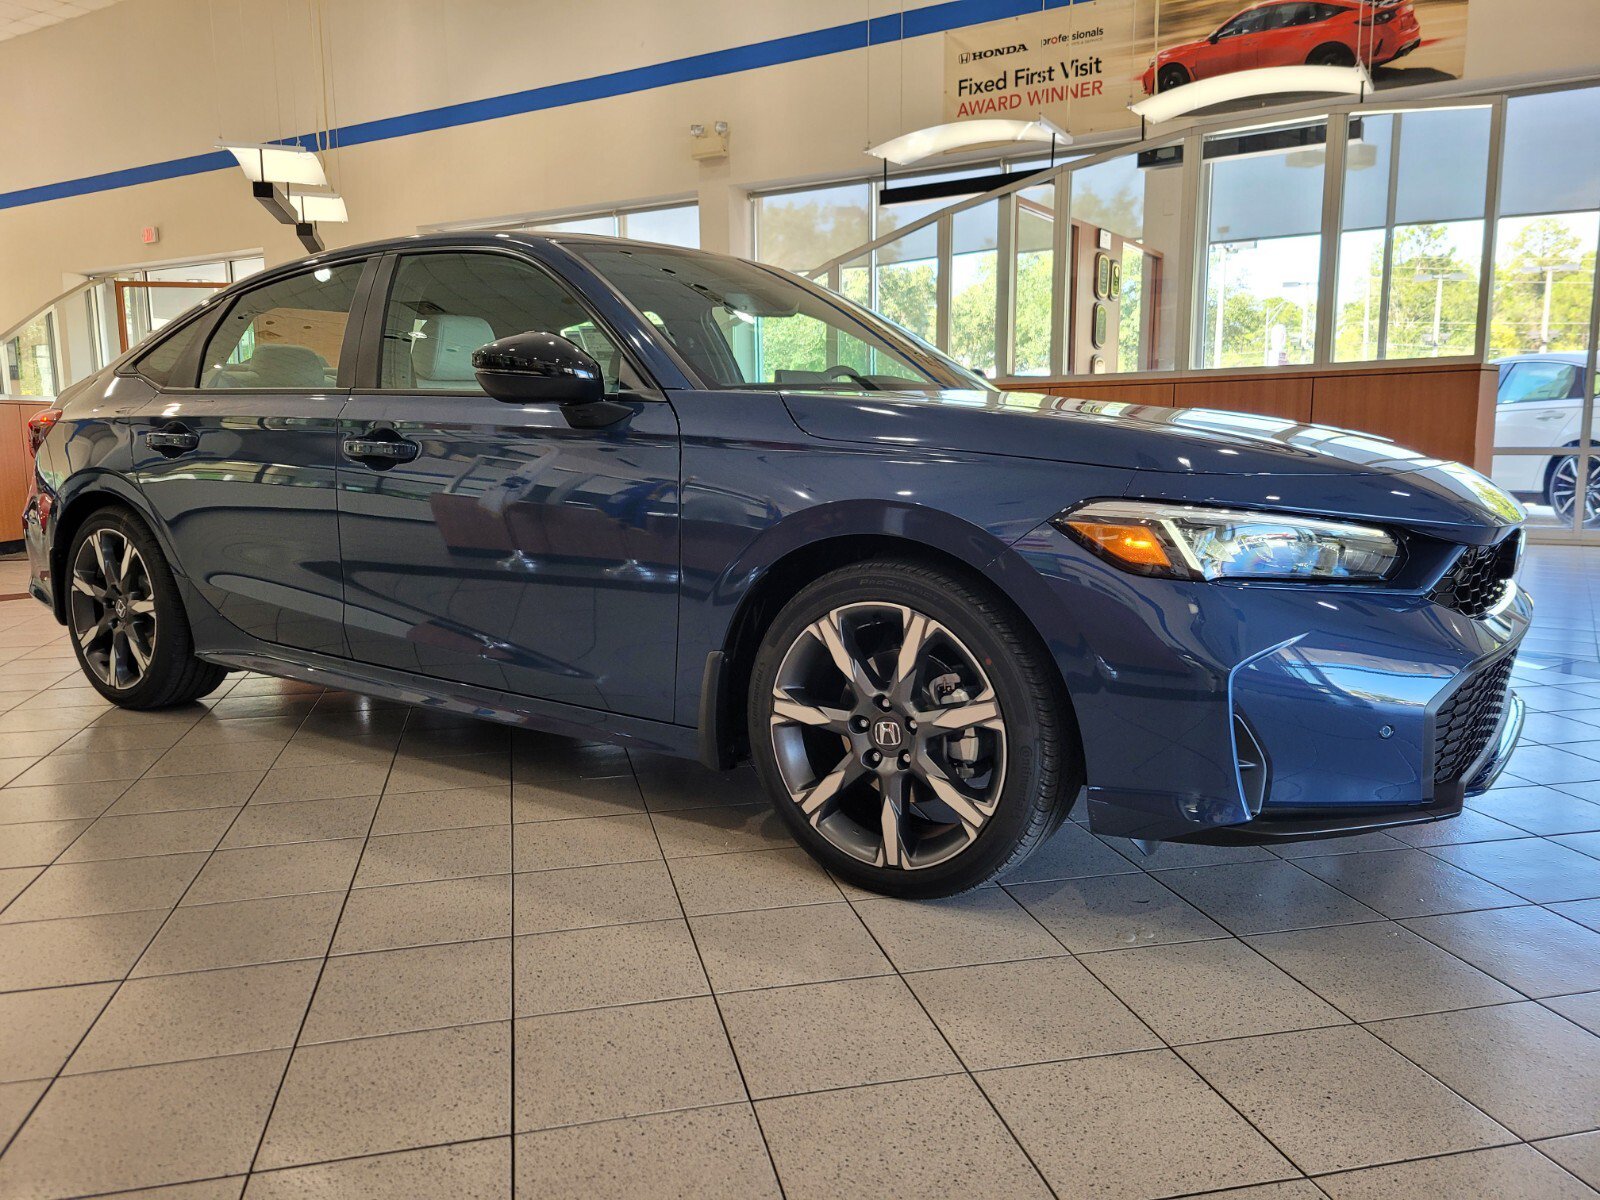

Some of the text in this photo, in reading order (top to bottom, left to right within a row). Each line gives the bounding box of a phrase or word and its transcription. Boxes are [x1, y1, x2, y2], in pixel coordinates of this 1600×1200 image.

[972, 43, 1028, 61] HONDA
[958, 56, 1103, 97] Fixed First Visit
[957, 80, 1103, 118] AWARD WINNER
